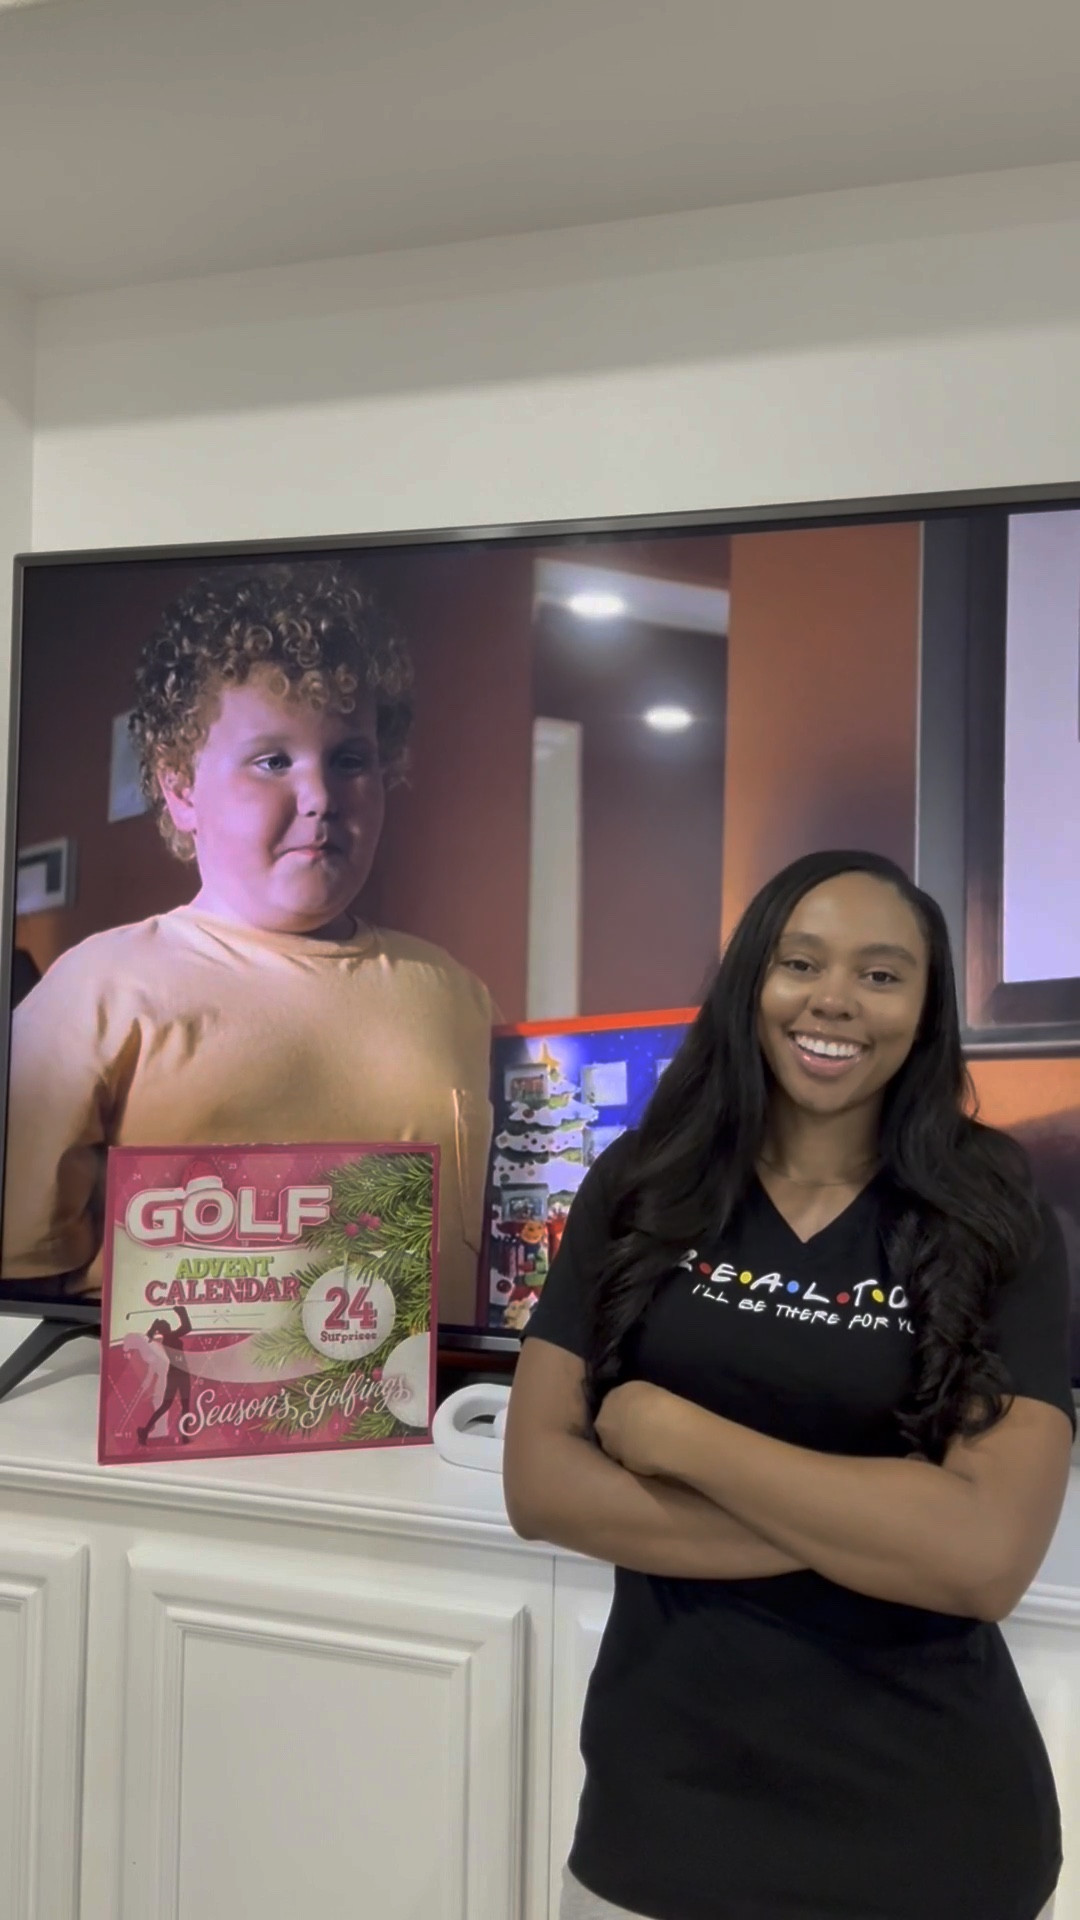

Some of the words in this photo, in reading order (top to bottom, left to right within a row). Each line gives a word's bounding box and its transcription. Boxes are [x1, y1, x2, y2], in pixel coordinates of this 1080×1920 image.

[125, 1185, 333, 1247] GOLF
[145, 1276, 302, 1306] CALENDAR
[175, 1256, 275, 1281] ADVENT
[324, 1286, 378, 1331] 24
[692, 1283, 730, 1304] I'LL
[738, 1298, 767, 1312] BE
[775, 1303, 842, 1325] THERE
[847, 1313, 889, 1330] FOR
[320, 1330, 377, 1344] Surprises
[178, 1387, 299, 1437] Season's
[299, 1371, 413, 1430] Golfings
